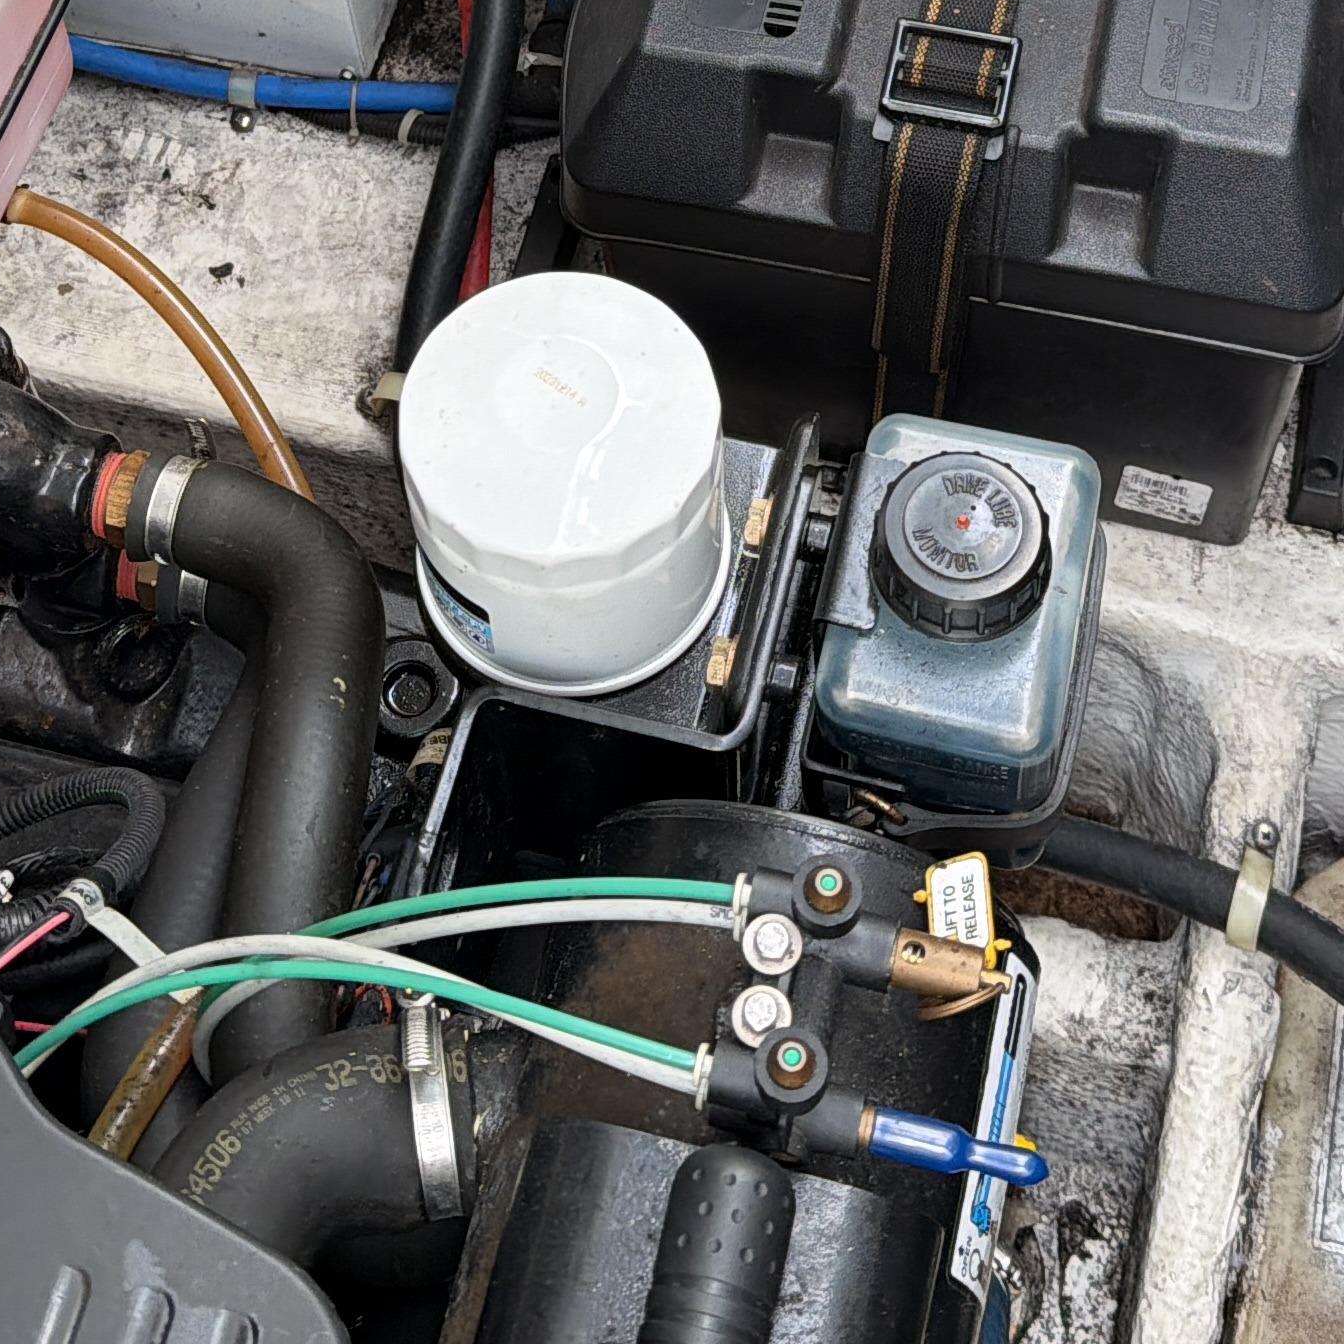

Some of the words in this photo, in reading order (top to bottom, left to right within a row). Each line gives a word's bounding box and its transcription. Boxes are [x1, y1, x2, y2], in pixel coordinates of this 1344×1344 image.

[985, 489, 1017, 529] LUBE
[912, 527, 979, 573] MONITOR
[943, 885, 956, 905] TO
[962, 873, 978, 940] RELEASE
[960, 1235, 973, 1278] OPEN
